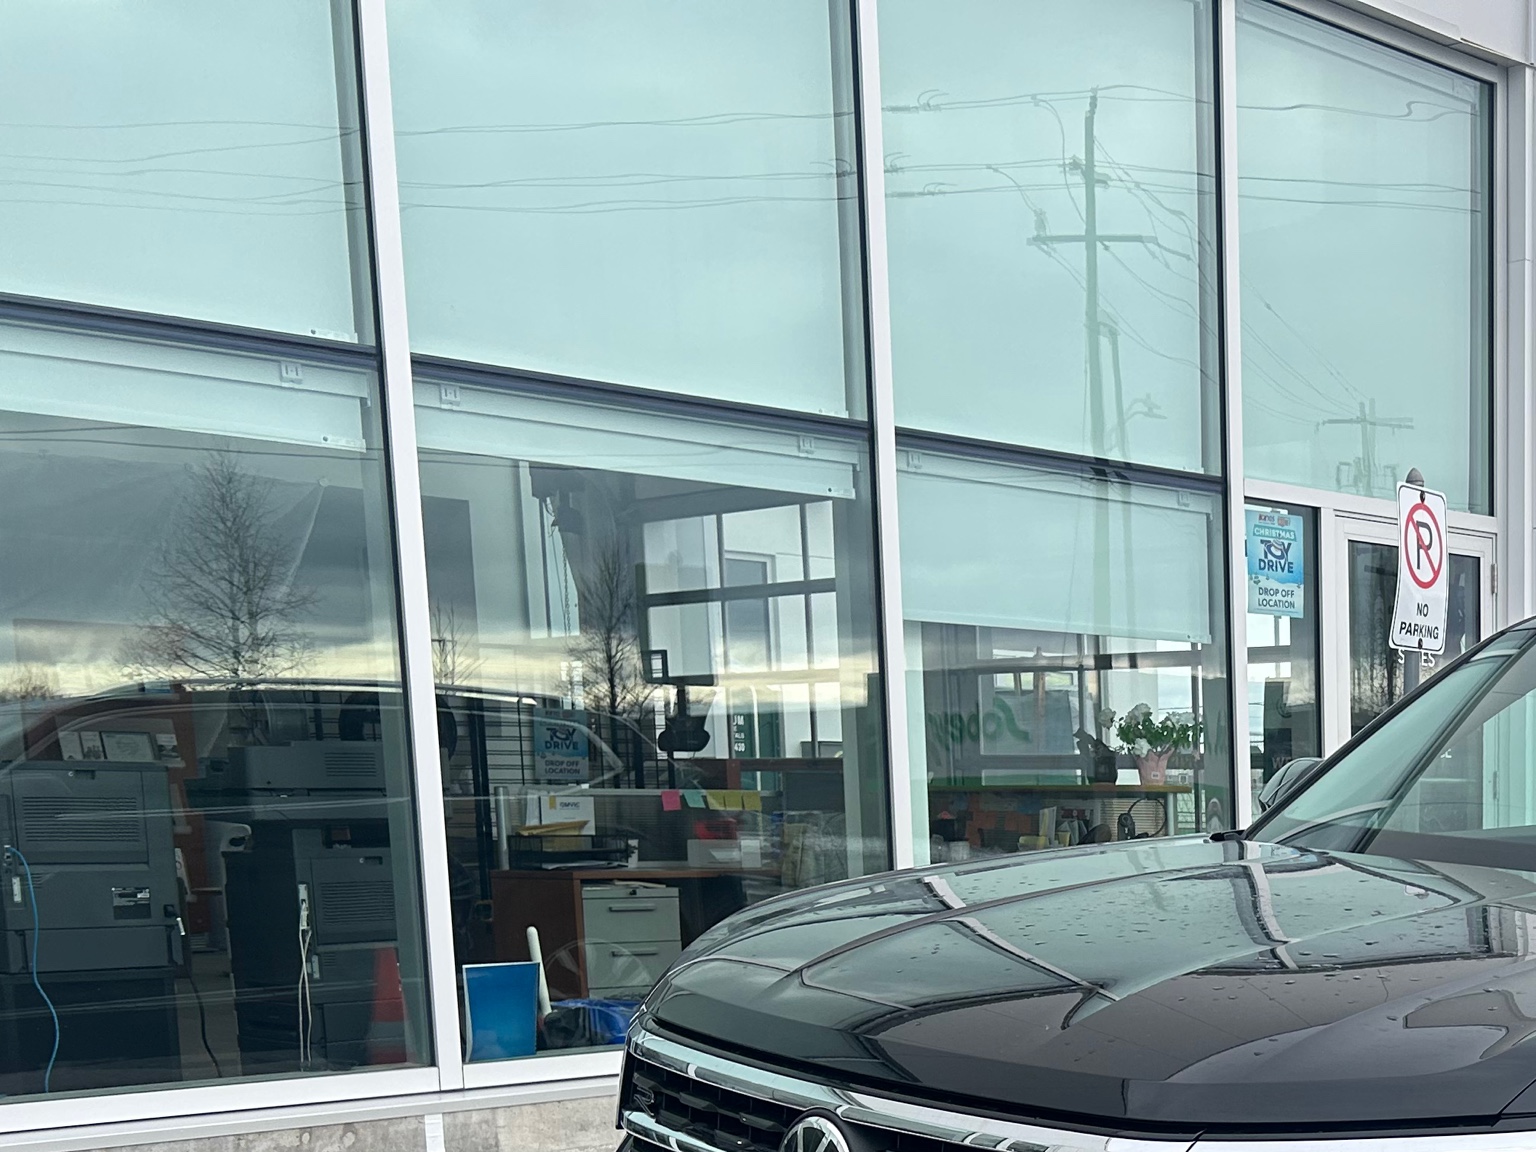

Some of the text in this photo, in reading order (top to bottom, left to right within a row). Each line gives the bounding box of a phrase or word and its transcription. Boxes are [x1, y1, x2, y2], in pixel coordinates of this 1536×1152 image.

[1254, 527, 1295, 540] CHRISTMAS
[1260, 539, 1292, 562] TOY
[1258, 559, 1294, 574] DRIVE
[1258, 587, 1295, 598] DROP OFF
[1258, 598, 1295, 609] LOCATION
[1416, 602, 1429, 617] NO
[1399, 621, 1439, 640] PARKING
[1397, 649, 1436, 667] SES
[546, 727, 576, 742] TOY
[544, 741, 579, 751] DRIVE
[544, 760, 580, 768] DROP OFF
[544, 767, 580, 775] LOCATION
